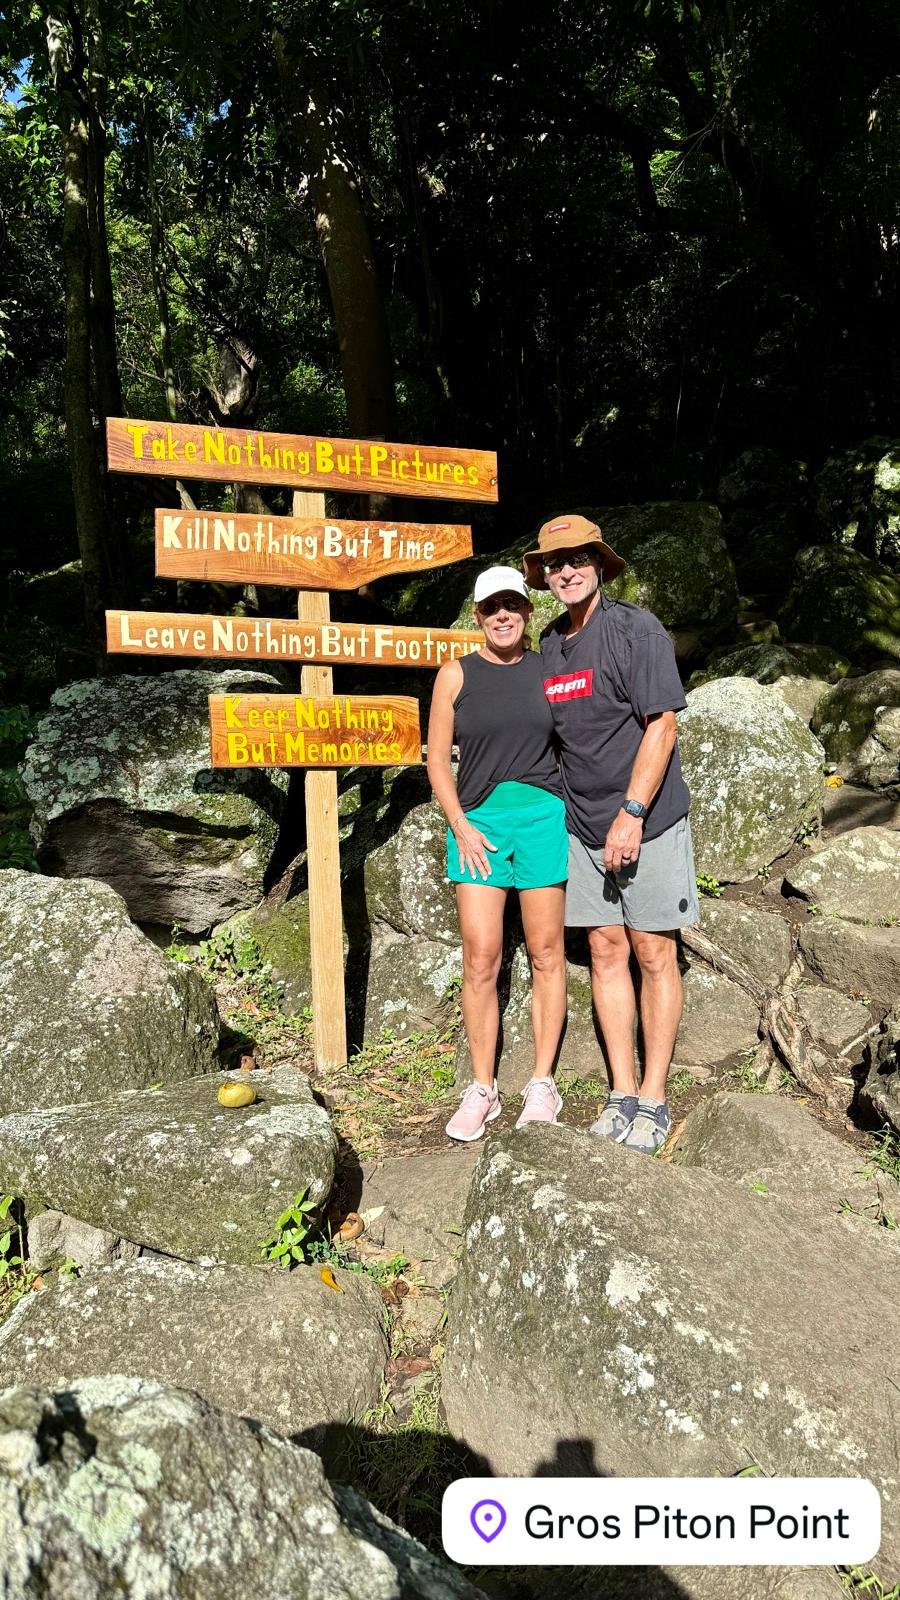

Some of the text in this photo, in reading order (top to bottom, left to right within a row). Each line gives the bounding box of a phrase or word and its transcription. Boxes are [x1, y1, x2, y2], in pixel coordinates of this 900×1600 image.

[127, 424, 480, 486] Take Nothing But Pictures
[162, 515, 436, 561] Kill Nothing But Time
[120, 613, 487, 664] Leave Nothing But Footprin
[223, 696, 394, 732] Keep Nothing
[227, 731, 402, 764] But Memories
